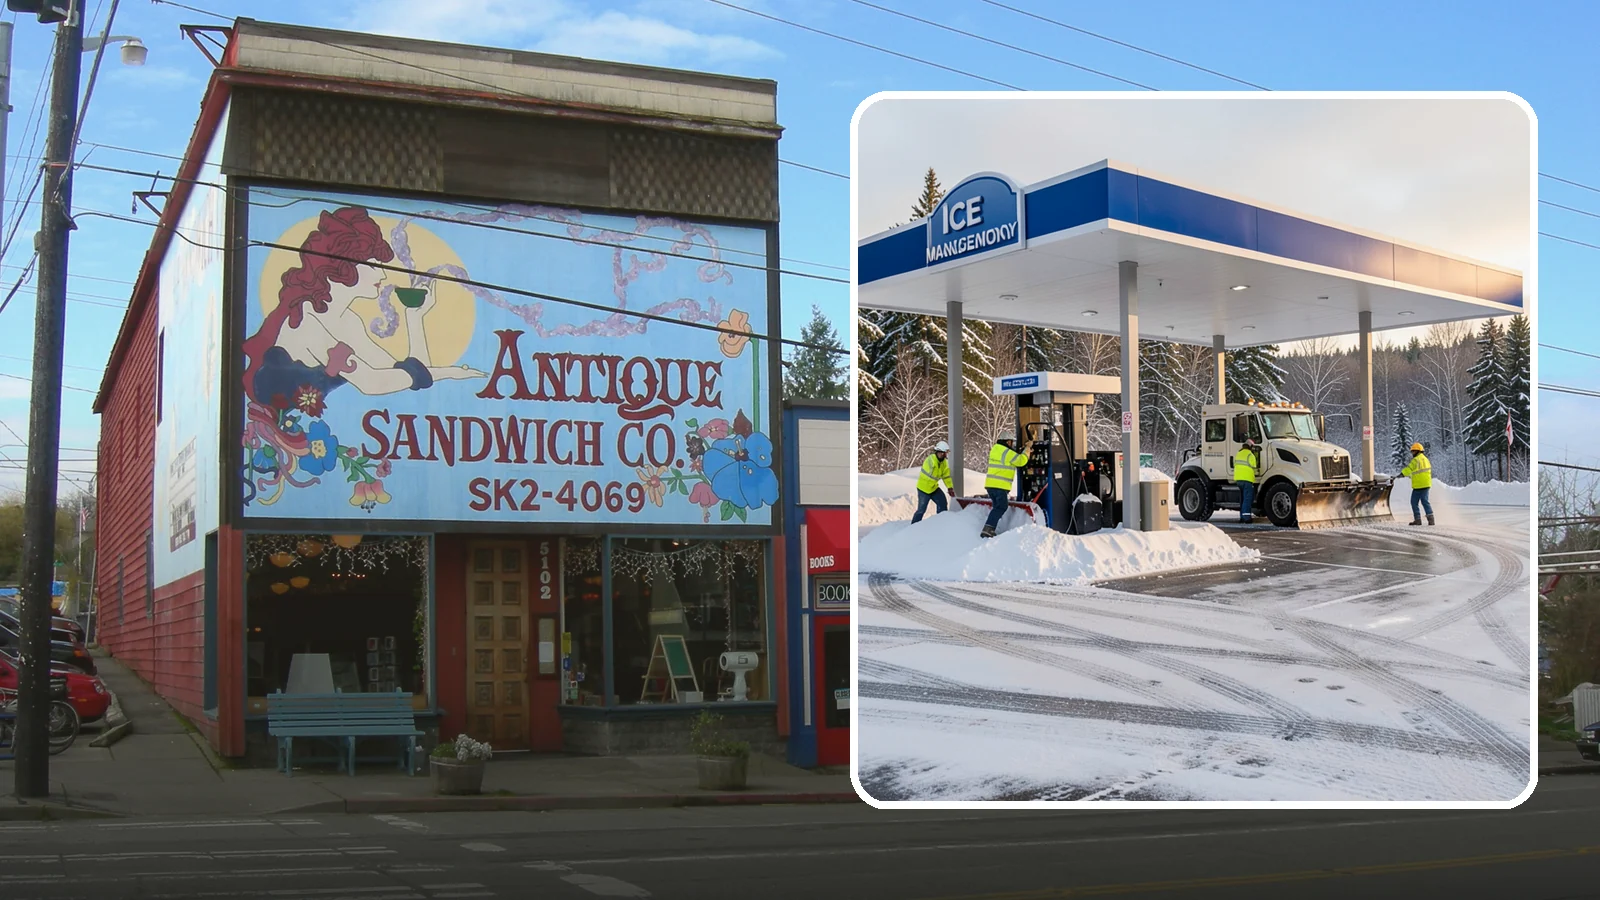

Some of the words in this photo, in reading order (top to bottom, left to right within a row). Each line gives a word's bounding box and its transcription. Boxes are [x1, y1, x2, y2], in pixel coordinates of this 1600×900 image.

[942, 195, 983, 235] ICE
[475, 328, 723, 421] ANTIQUE
[361, 408, 604, 468] SANDWICH
[617, 422, 684, 468] CO.
[468, 476, 645, 513] SK2-4069
[539, 541, 552, 600] 5102
[809, 555, 835, 569] BOOKS
